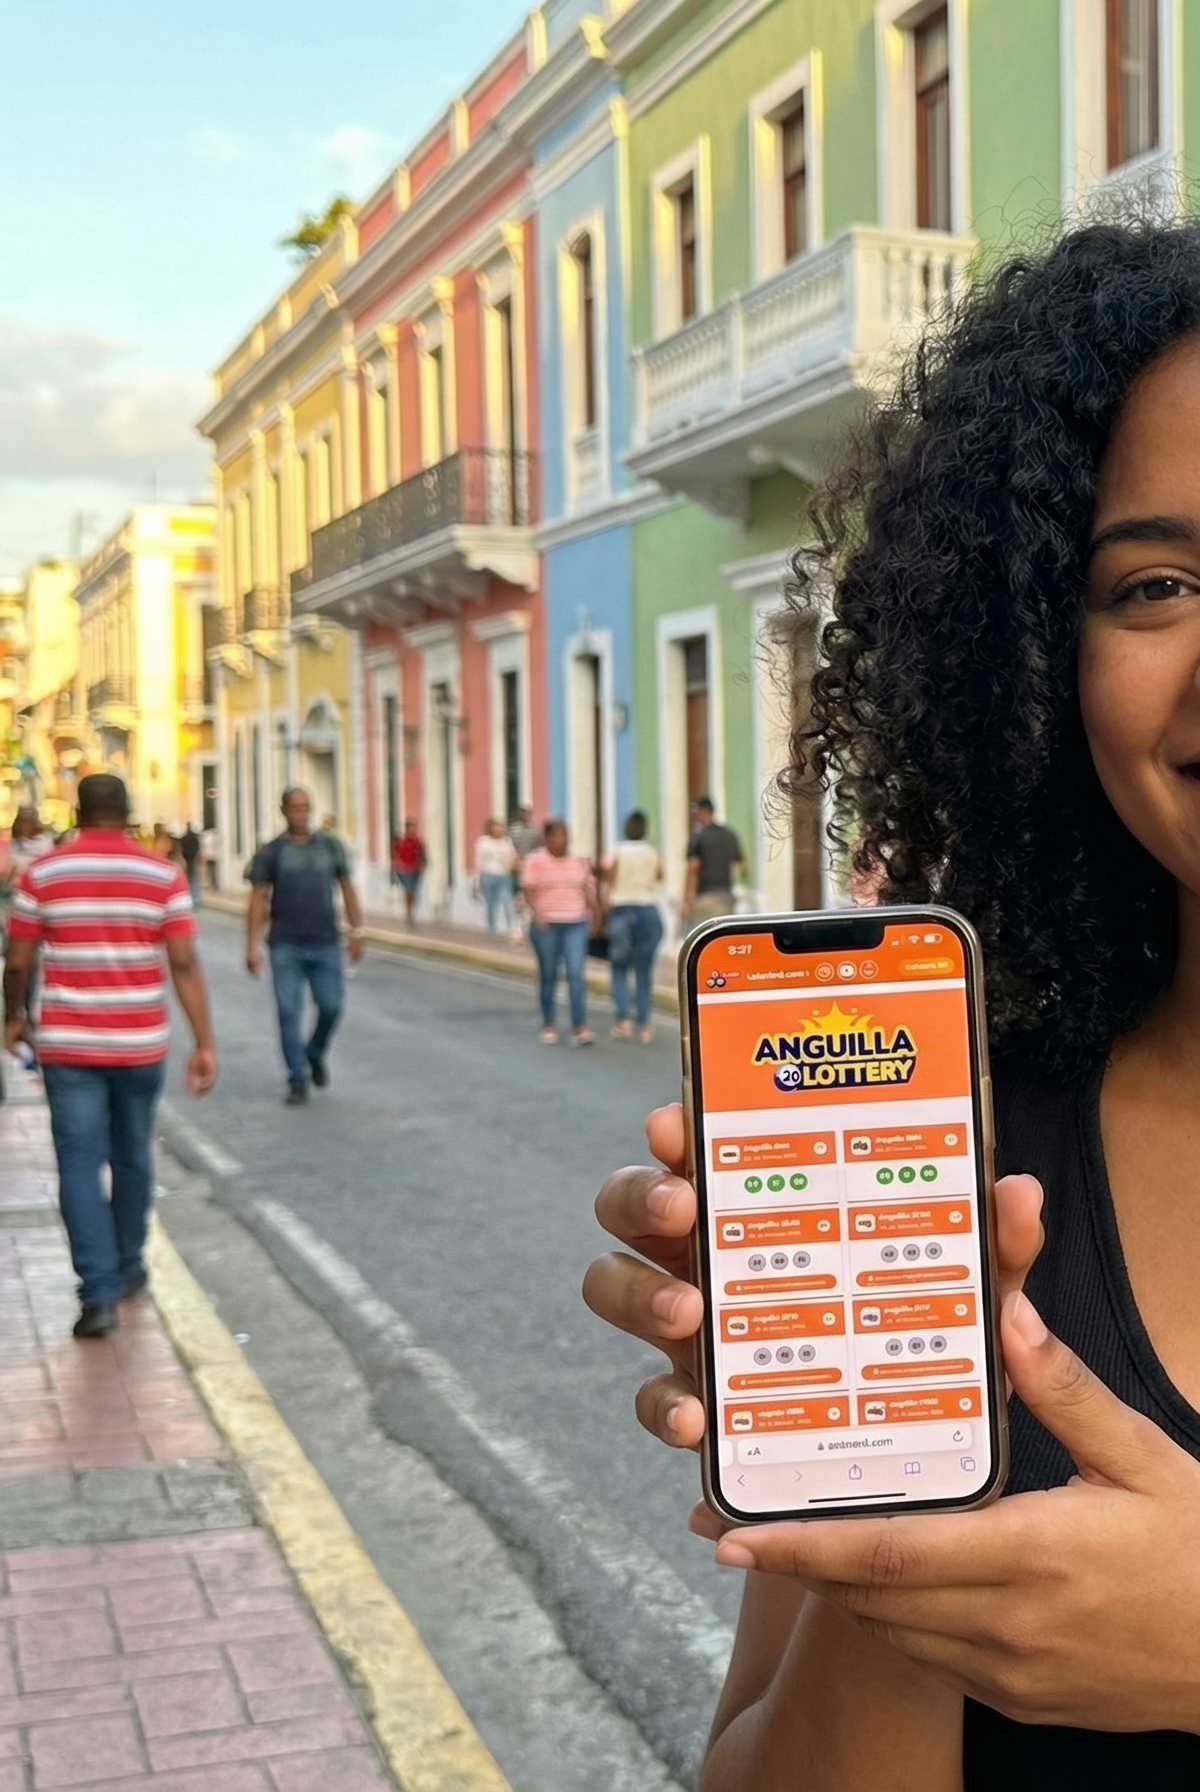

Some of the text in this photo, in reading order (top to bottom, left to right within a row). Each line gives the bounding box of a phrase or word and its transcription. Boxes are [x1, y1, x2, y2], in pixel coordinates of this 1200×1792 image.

[755, 1030, 914, 1061] ANGUILLA
[783, 1060, 913, 1086] 20 LOTTERY
